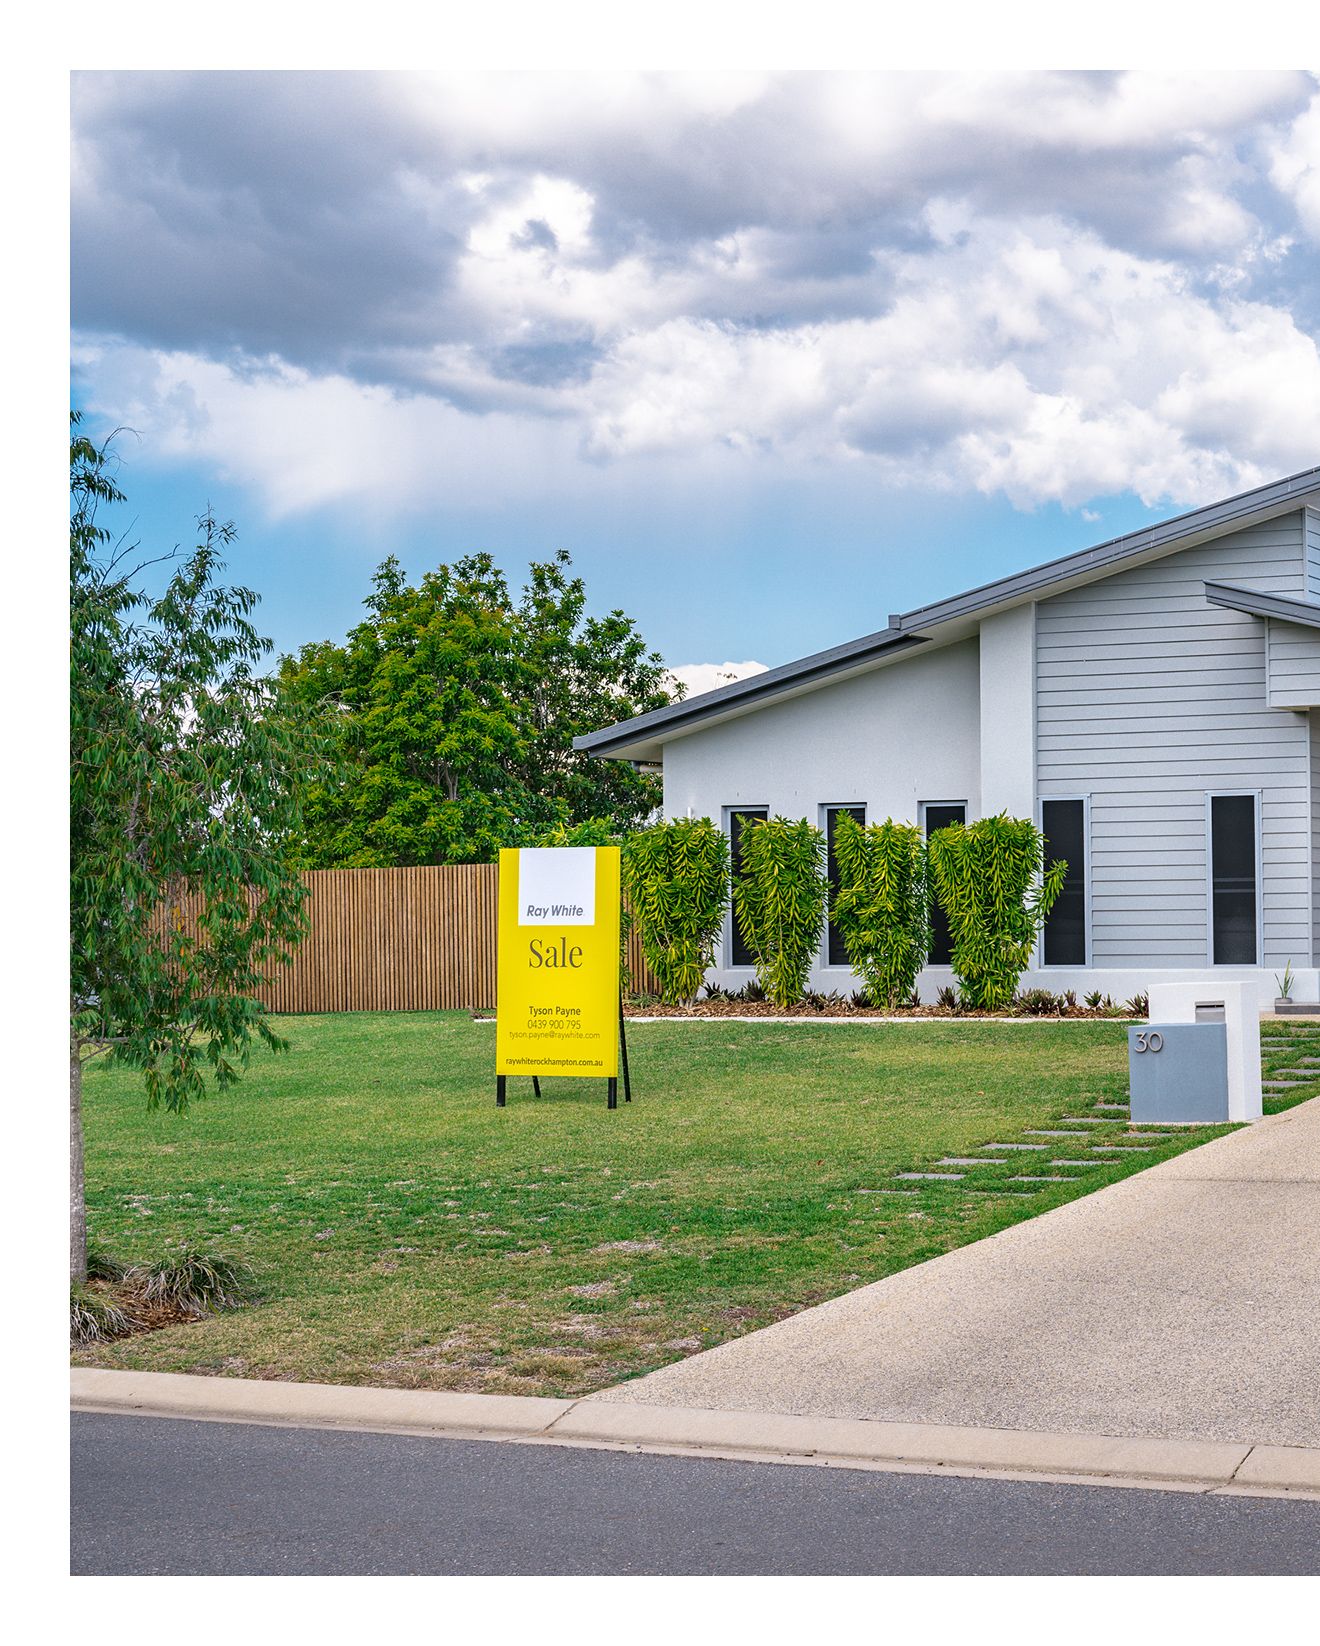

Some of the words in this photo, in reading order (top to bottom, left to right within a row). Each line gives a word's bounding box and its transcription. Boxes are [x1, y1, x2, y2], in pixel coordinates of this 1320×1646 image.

[527, 905, 549, 919] Ray
[551, 905, 584, 917] White
[529, 936, 583, 968] Sale
[529, 1006, 553, 1017] Tyson
[555, 1006, 581, 1018] Payne
[527, 1019, 547, 1030] 0439
[548, 1019, 564, 1030] 900
[566, 1019, 581, 1030] 795
[509, 1030, 600, 1040] tyson.payne@raywhite.com
[1134, 1031, 1164, 1054] 30
[505, 1057, 603, 1067] raywhiterockhampton.com.au
